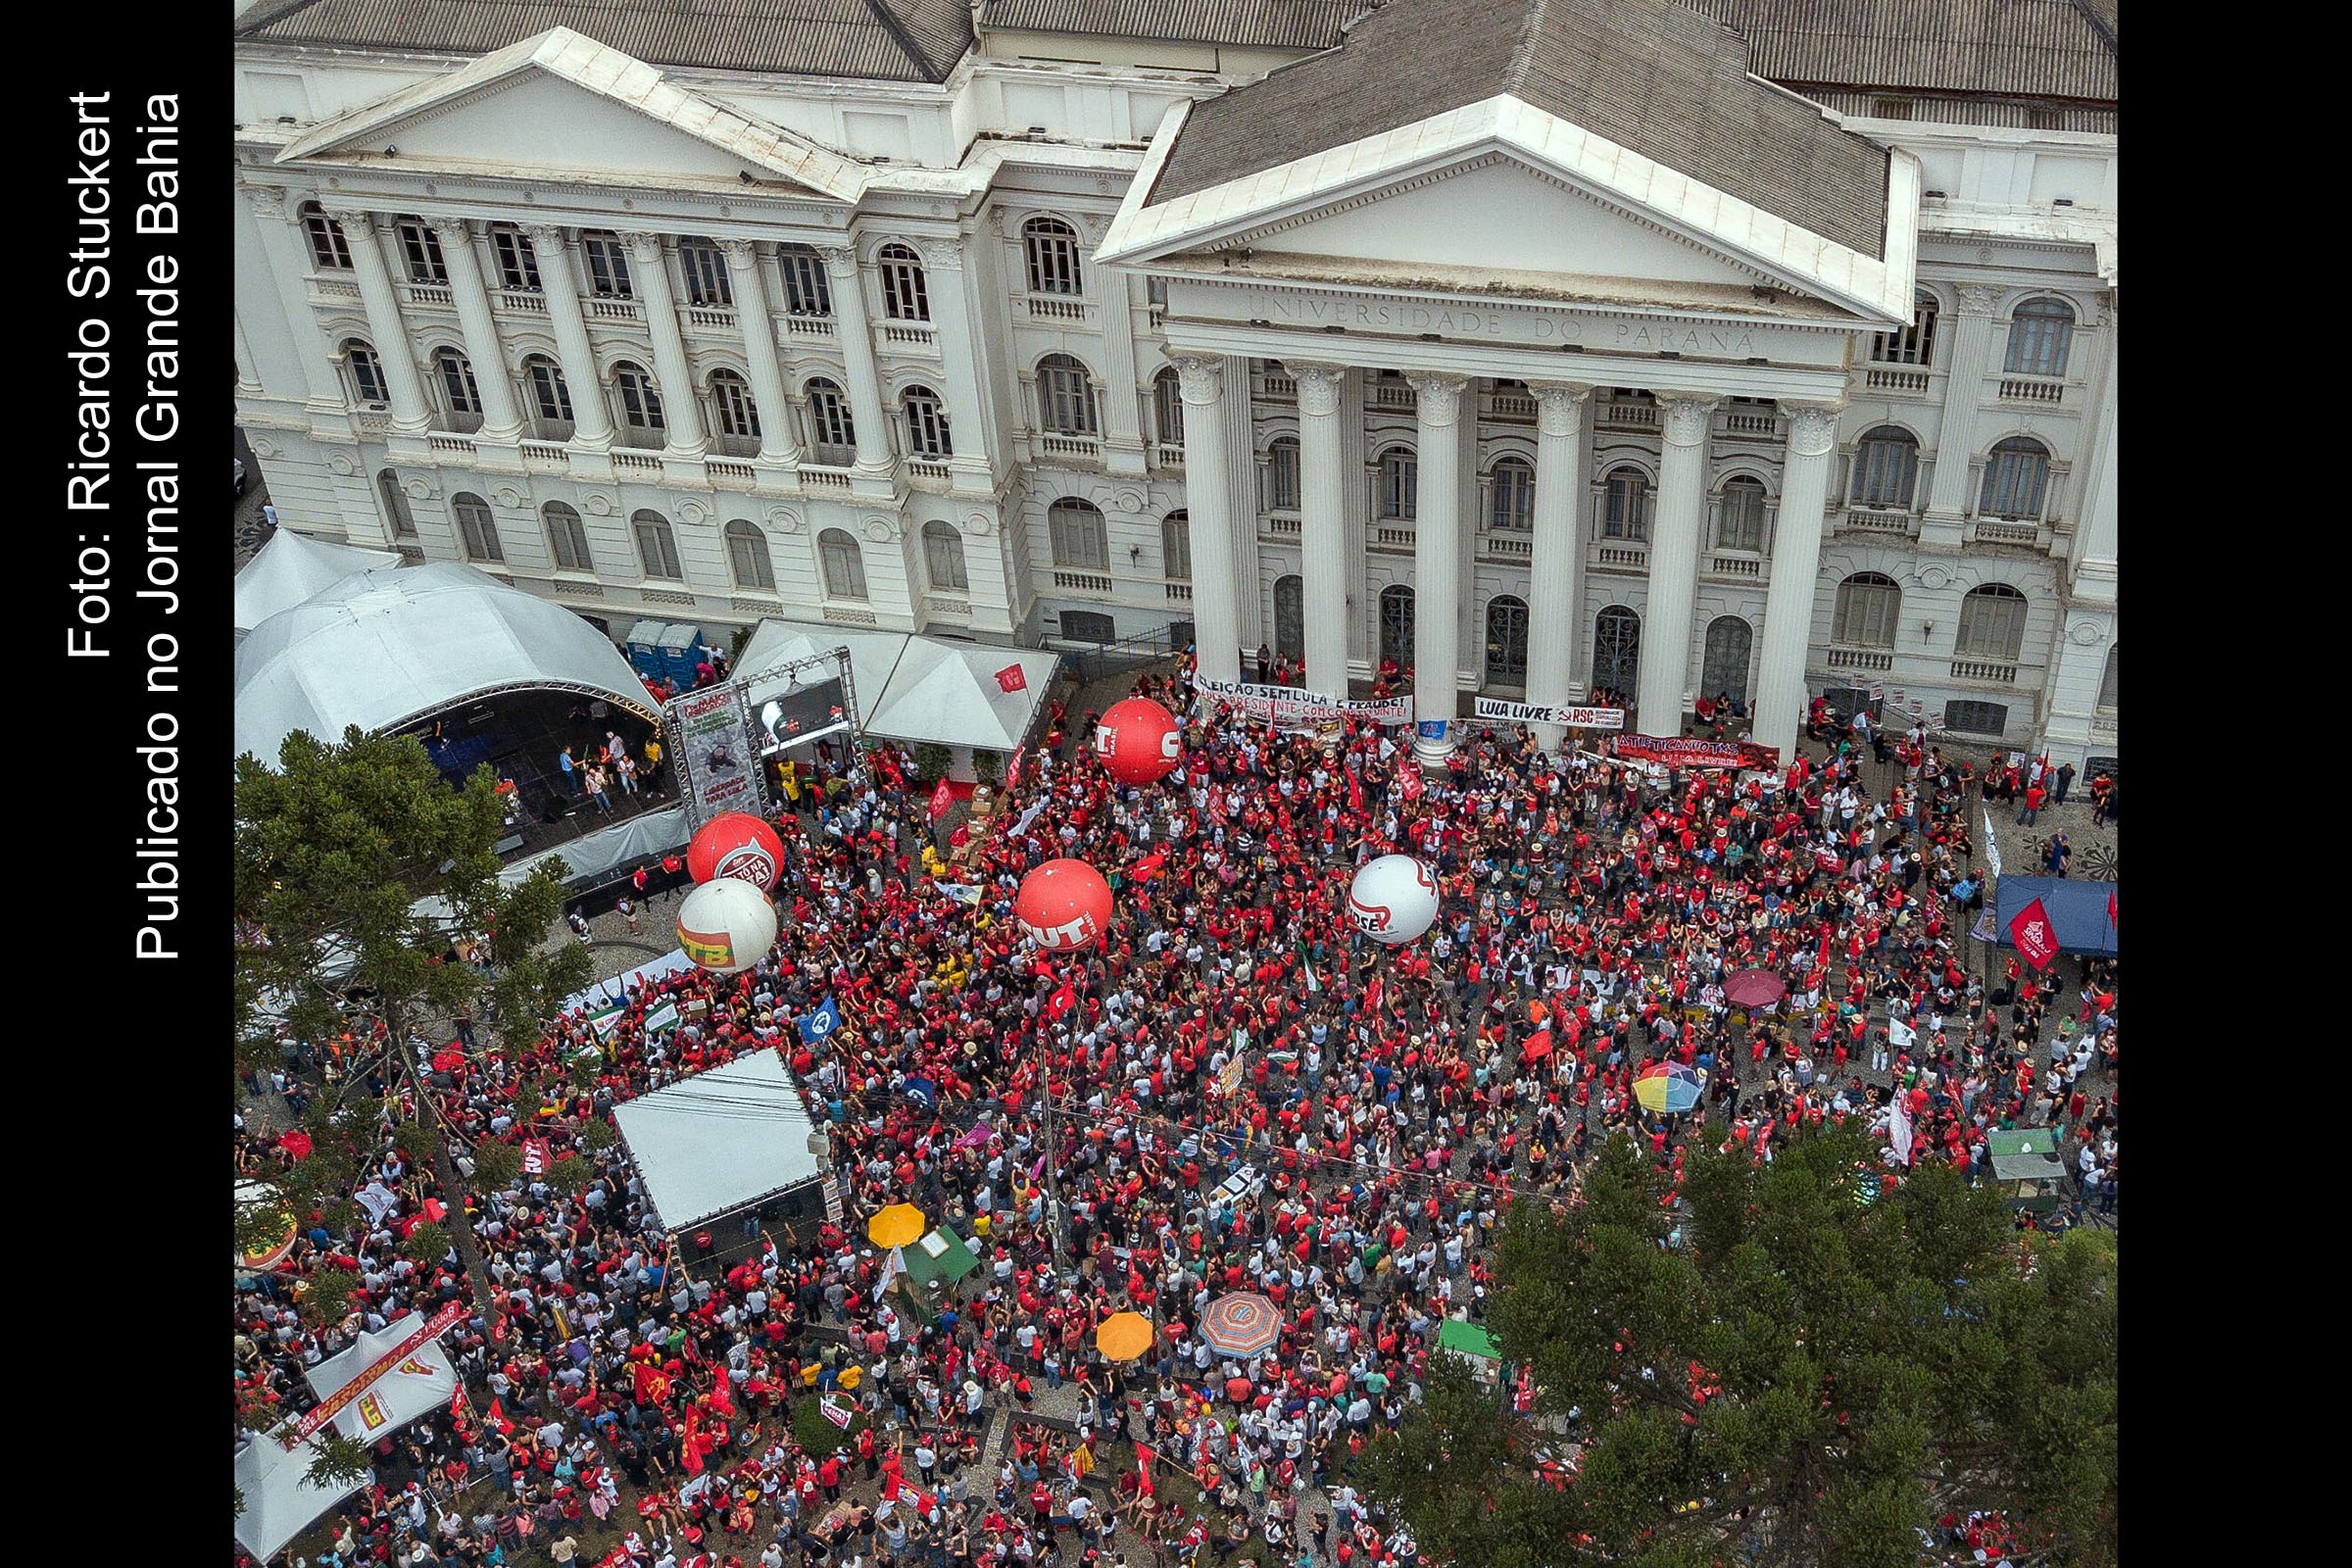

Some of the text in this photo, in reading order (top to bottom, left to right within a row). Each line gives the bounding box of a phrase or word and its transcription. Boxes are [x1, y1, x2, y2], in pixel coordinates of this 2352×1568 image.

[1249, 295, 1755, 354] UNIVERSIDADE DO PARANÁ
[1229, 696, 1298, 713] PRESIDNTE
[1259, 687, 1290, 701] SEM
[1294, 690, 1327, 705] LULA
[1479, 701, 1510, 717] LULA
[1512, 704, 1553, 721] LIVRE
[750, 859, 765, 872] NA
